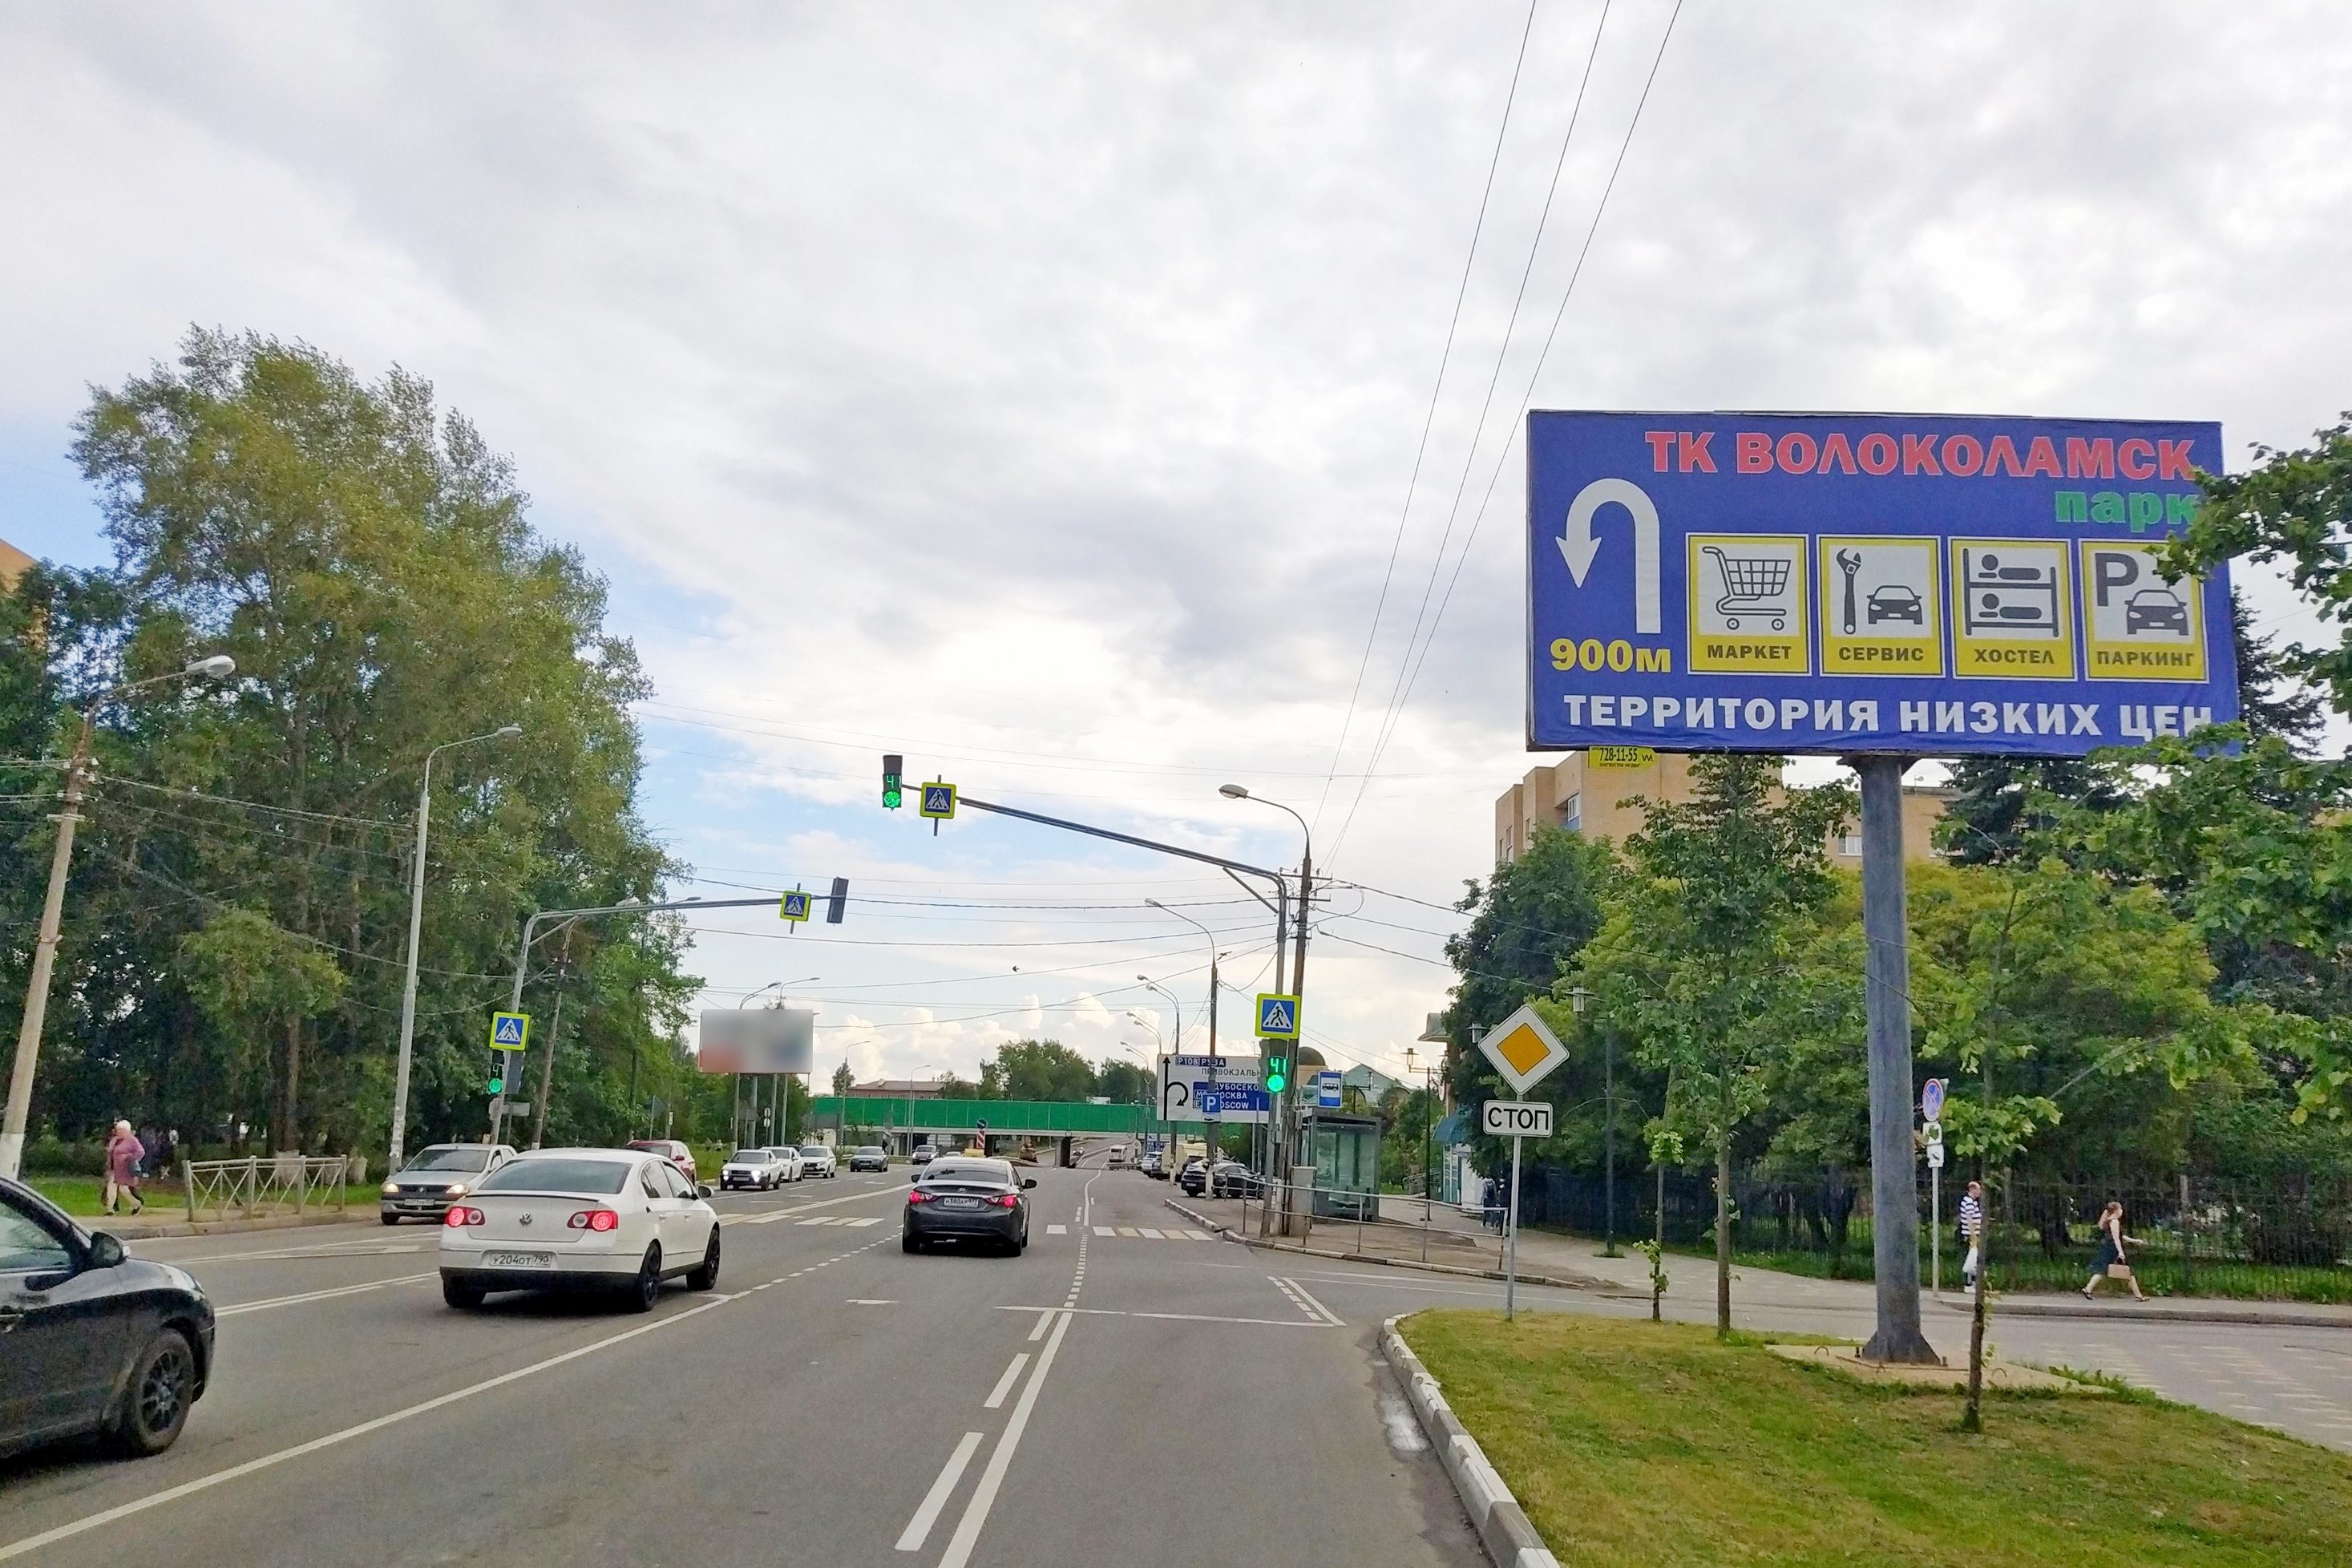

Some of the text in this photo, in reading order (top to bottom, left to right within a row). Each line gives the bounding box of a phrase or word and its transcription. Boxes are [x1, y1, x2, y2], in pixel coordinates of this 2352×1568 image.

[1645, 431, 2196, 480] ТК ВОЛОКОЛАМСК
[2055, 491, 2199, 533] парк
[1707, 645, 1792, 660] МАРКЕТ
[1838, 647, 1924, 662] СЕРВИС
[1974, 649, 2055, 665] ХОСТЕЛ
[2097, 651, 2195, 667] ПАРКИНГ
[1563, 694, 2213, 742] ТЕРРИТОРИЯ НИЗКИХ ЦЕН
[1600, 747, 1638, 762] 728-11-55
[1215, 1091, 1247, 1100] ОСКВА
[1488, 1107, 1549, 1130] СТОП
